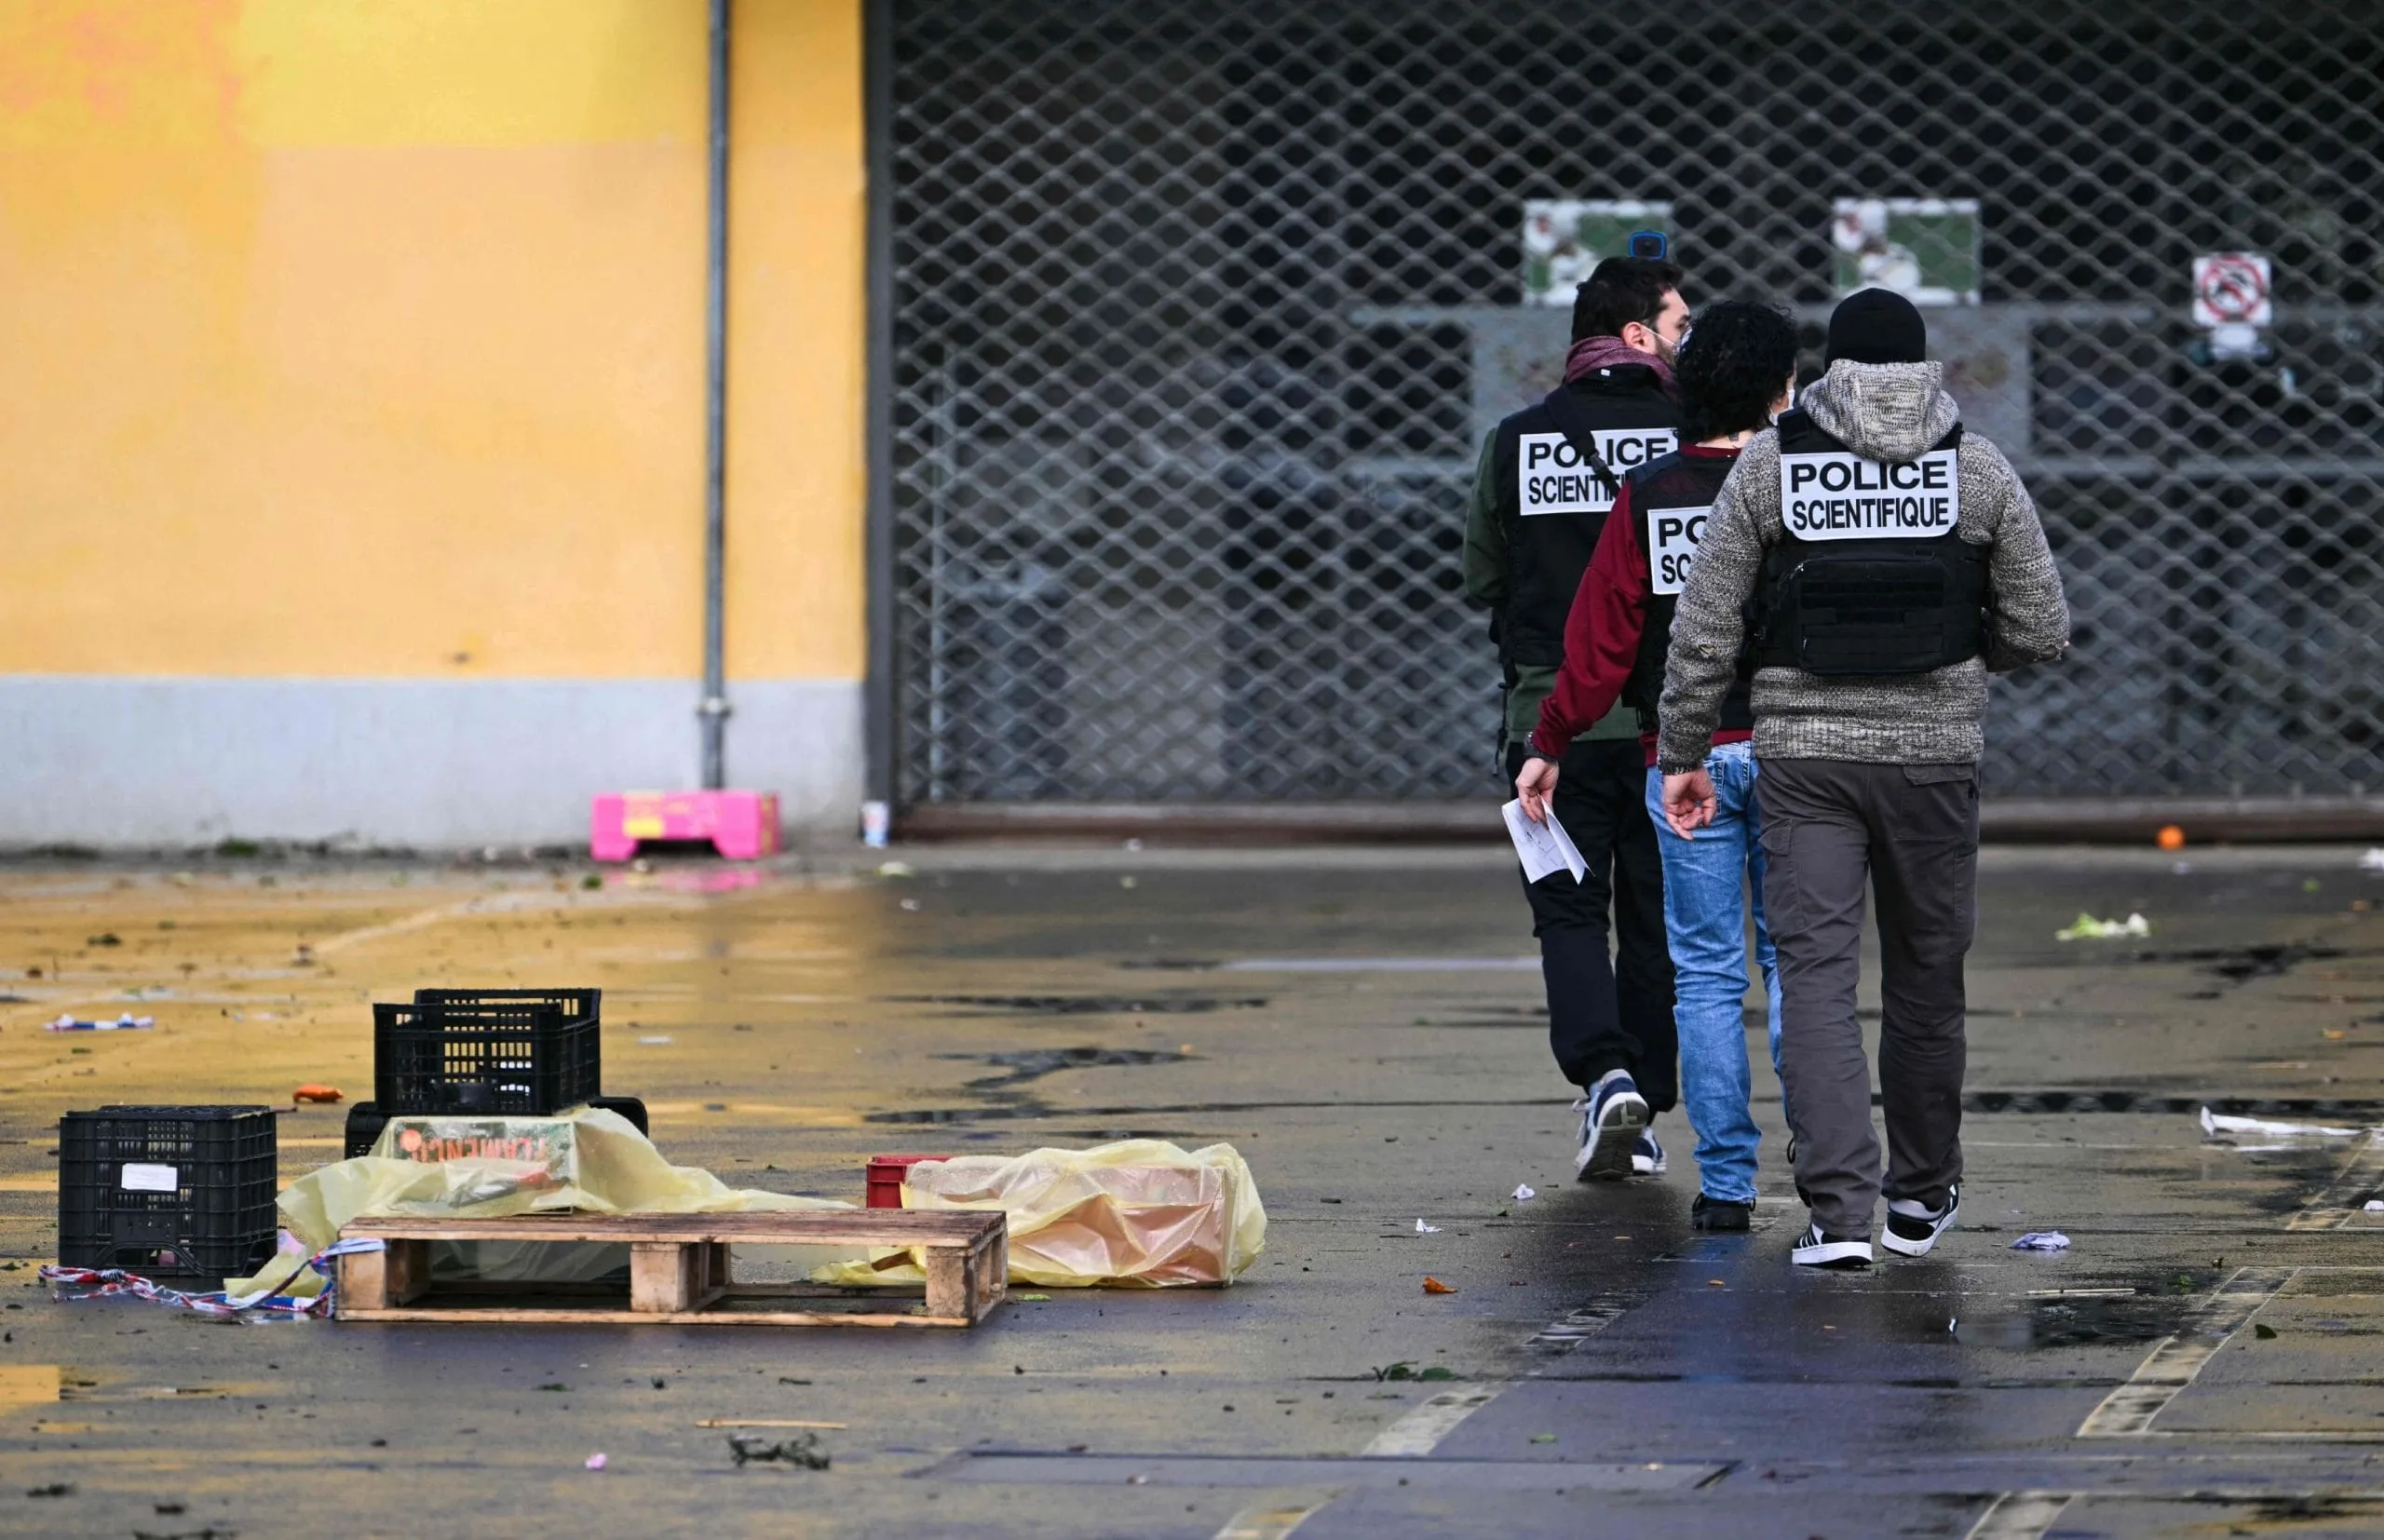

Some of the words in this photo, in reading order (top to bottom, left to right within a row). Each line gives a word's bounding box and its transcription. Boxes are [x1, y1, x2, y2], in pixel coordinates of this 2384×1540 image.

[1528, 438, 1670, 469] POICE
[1791, 460, 1949, 493] POLICE
[1792, 496, 1950, 531] SCIENTIFIQUE
